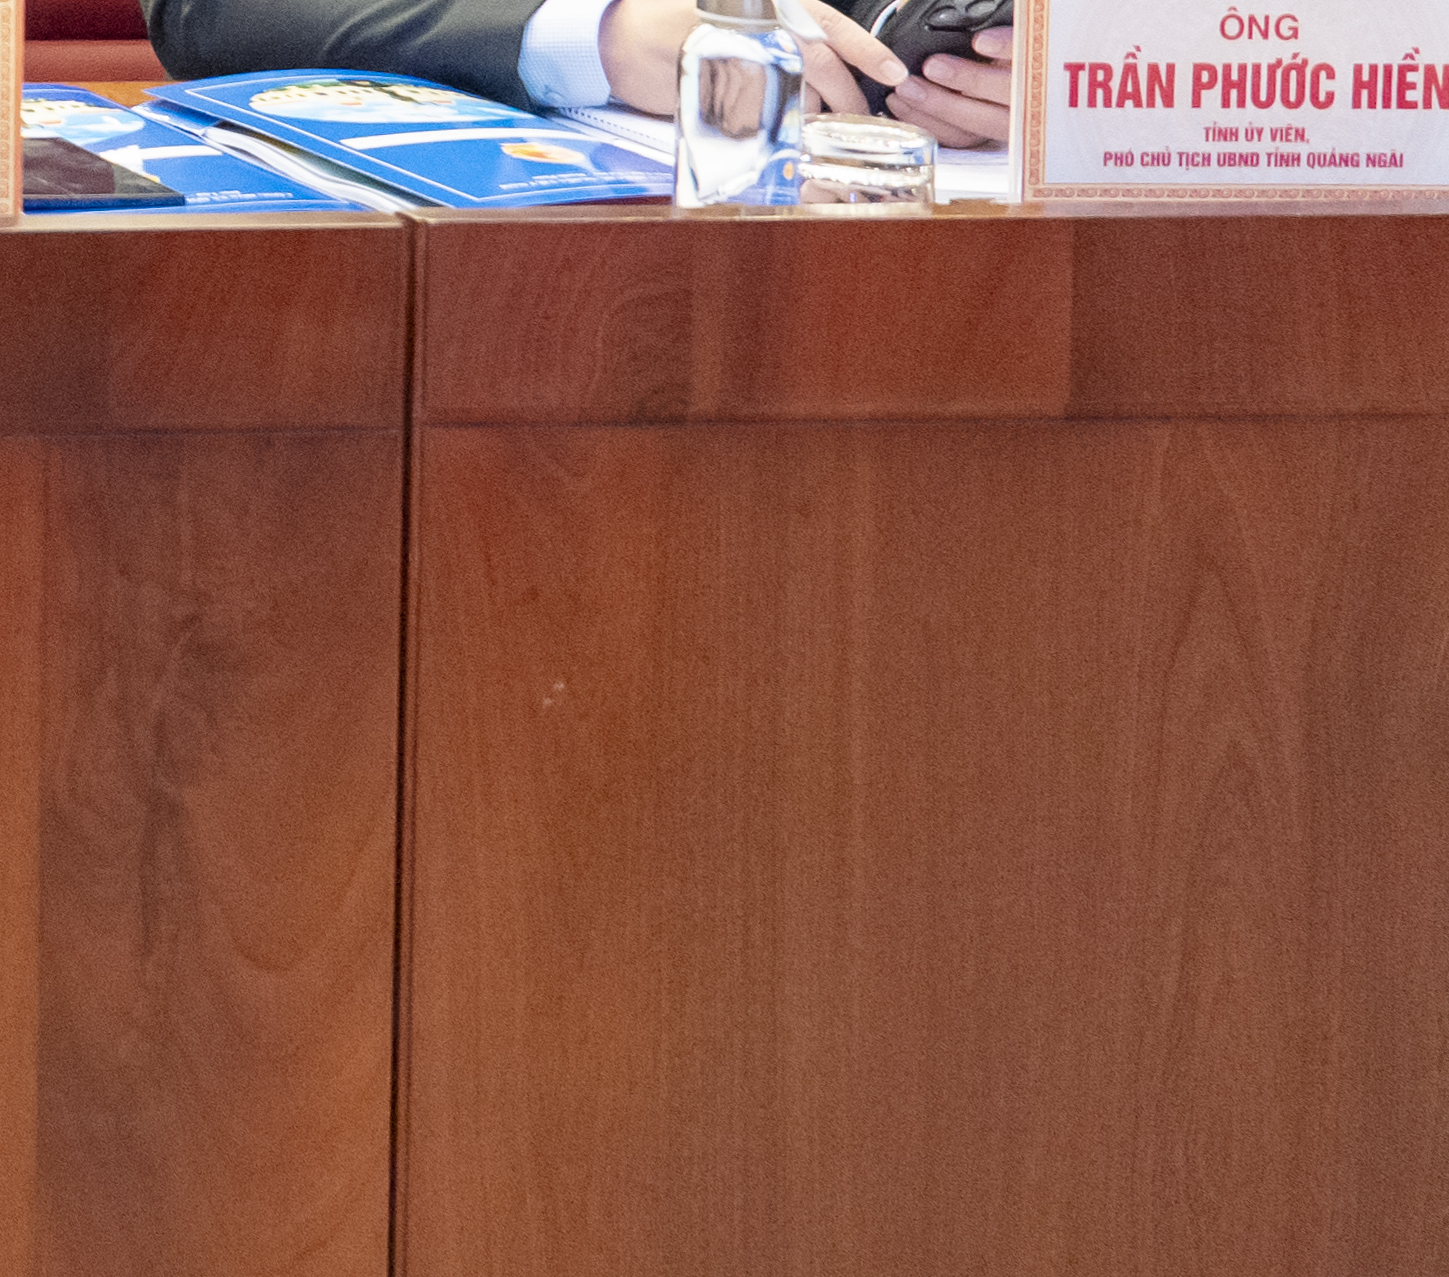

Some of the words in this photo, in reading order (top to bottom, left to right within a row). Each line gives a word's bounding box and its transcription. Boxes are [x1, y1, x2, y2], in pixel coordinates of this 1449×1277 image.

[1219, 7, 1300, 41] ÔNG
[1063, 45, 1176, 110] TRẦN
[1191, 52, 1337, 111] PHƯỚC
[1352, 47, 1449, 110] HIỀN
[1203, 122, 1240, 143] TỈNH
[1245, 122, 1264, 142] ỦY
[1270, 124, 1310, 143] VIÊN,
[1103, 148, 1135, 167] PHÓ
[1140, 146, 1172, 167] CHỦ
[1178, 151, 1212, 170] TỊCH
[1217, 152, 1260, 167] UBND
[1266, 146, 1302, 168] TỈNH
[1306, 148, 1361, 168] QUẢNG
